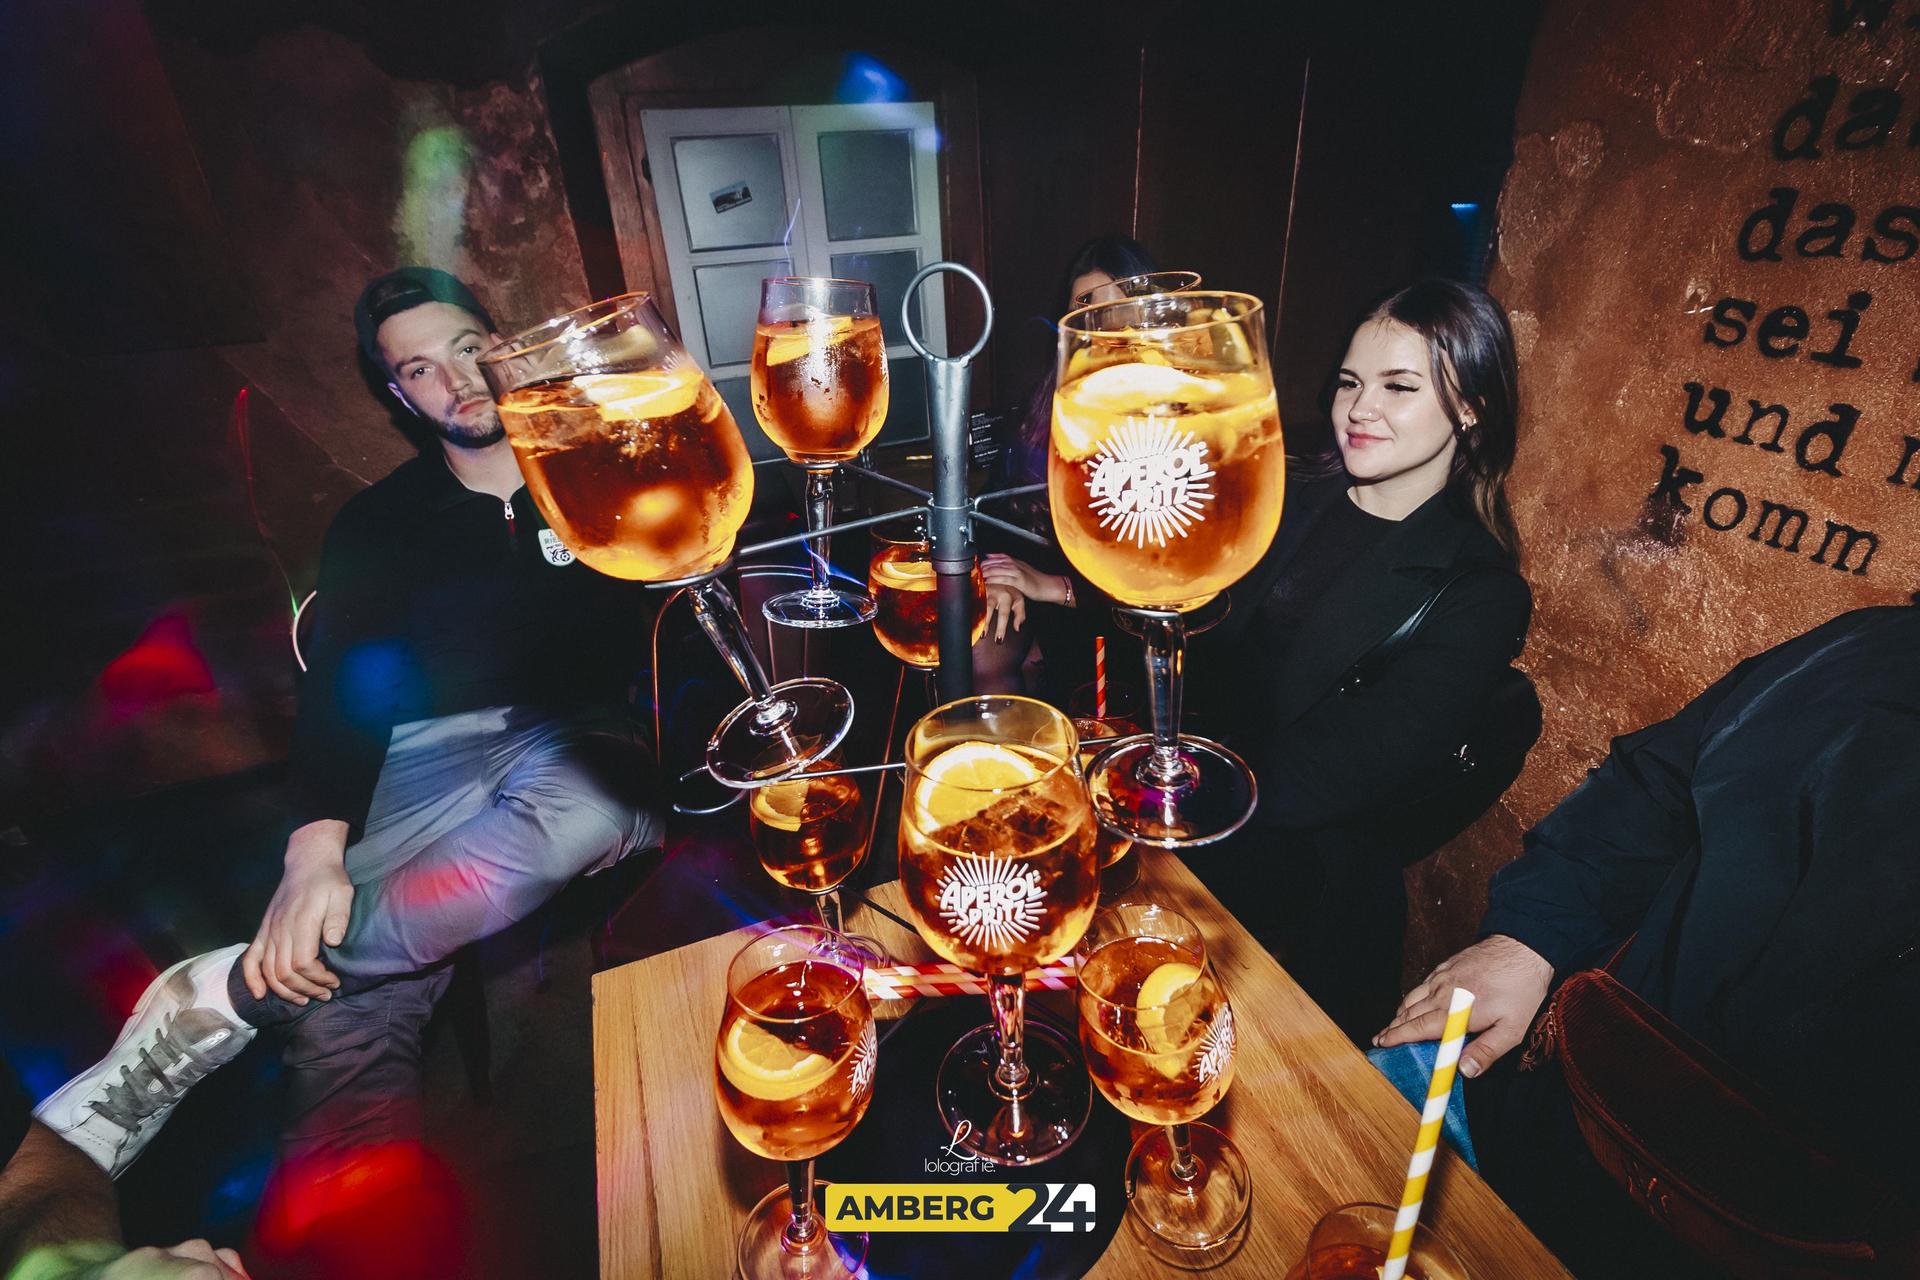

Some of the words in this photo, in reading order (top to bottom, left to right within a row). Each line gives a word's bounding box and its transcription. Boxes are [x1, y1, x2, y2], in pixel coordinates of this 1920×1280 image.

[1773, 75, 1920, 161] da
[1738, 187, 1920, 264] das
[1704, 290, 1872, 368] sei
[1682, 380, 1862, 478] und
[1090, 443, 1208, 497] APEROL
[1650, 444, 1880, 576] komm
[940, 872, 1042, 910] APEROL
